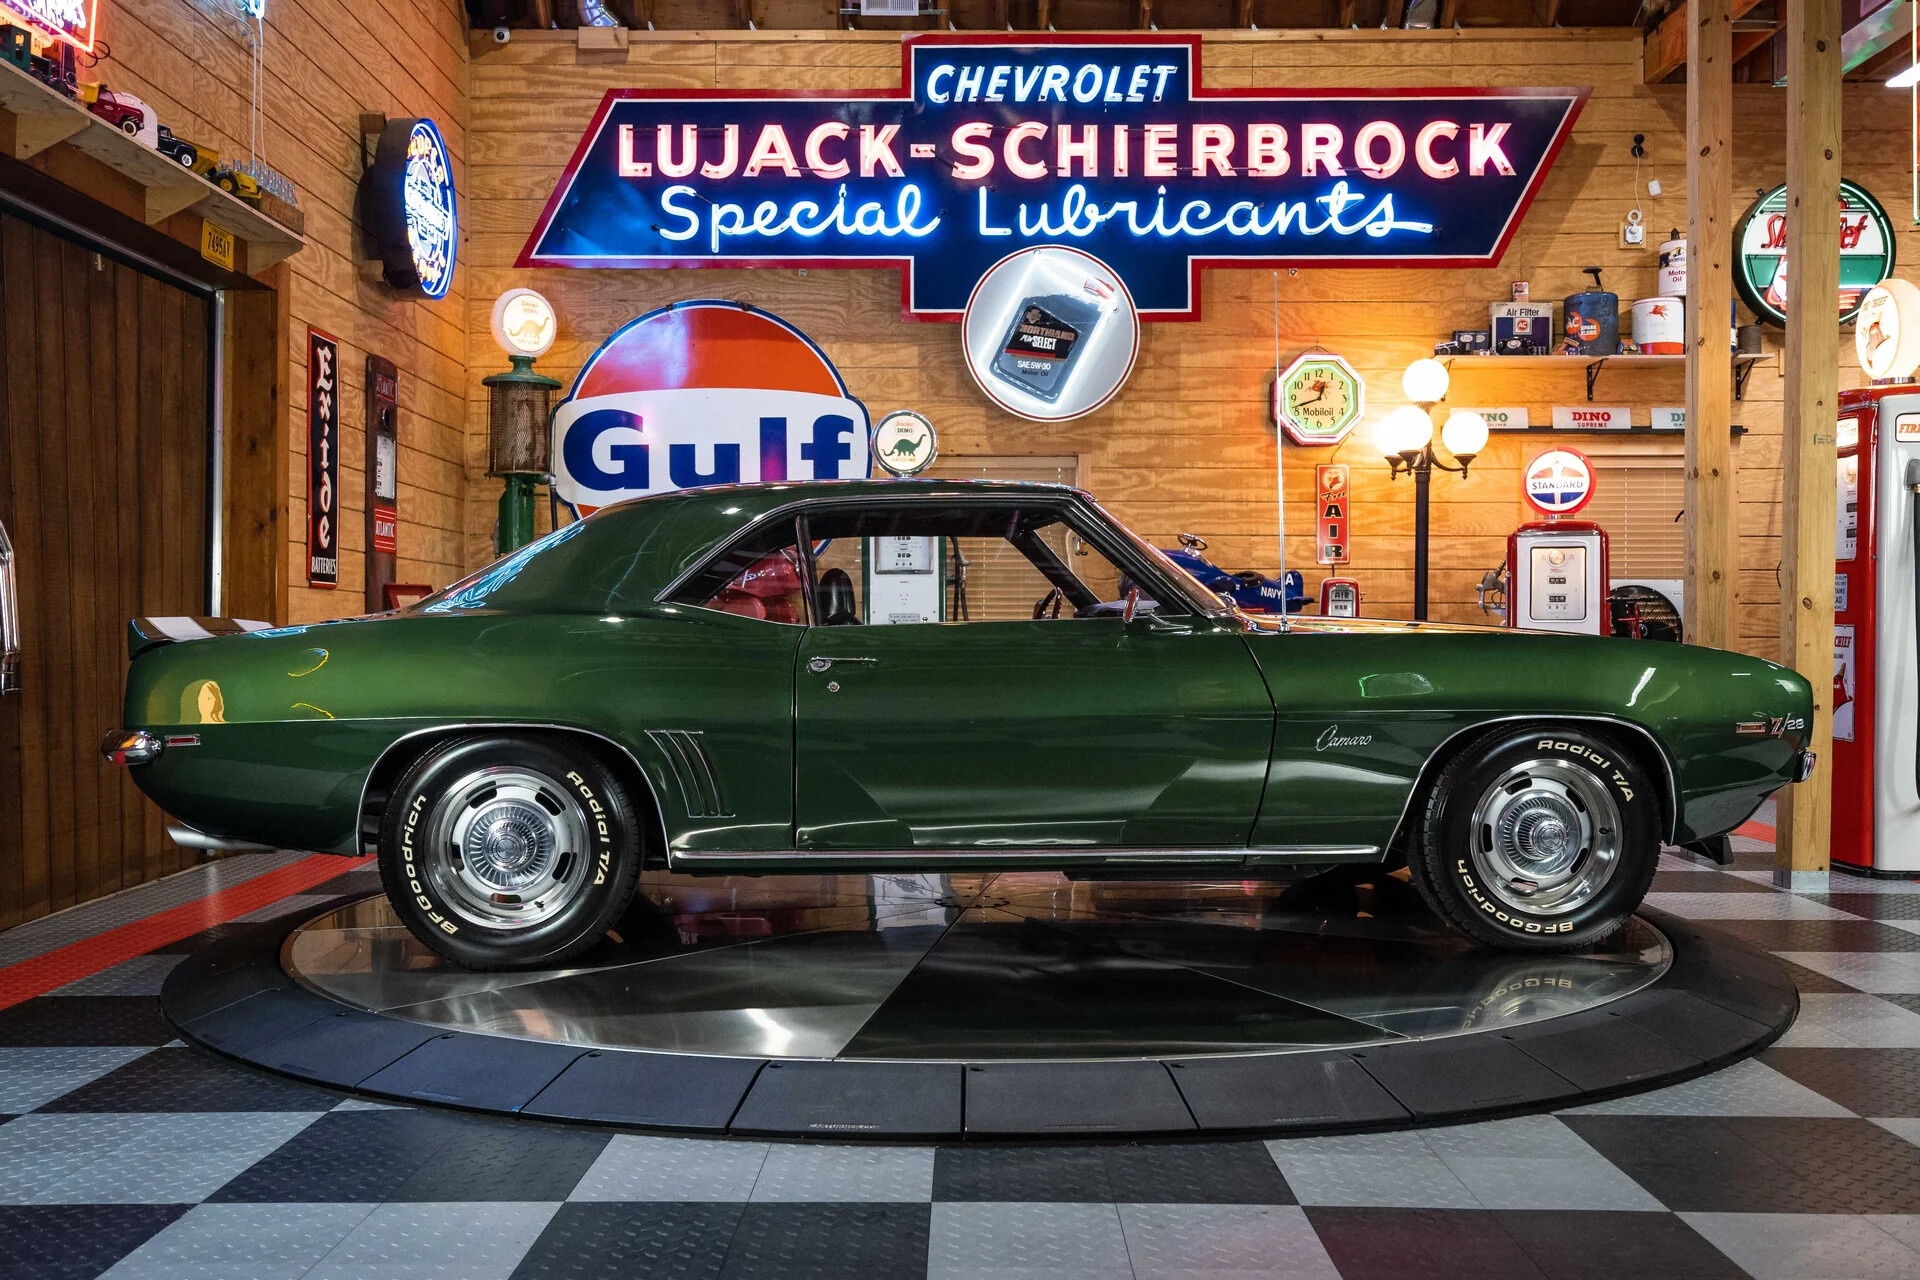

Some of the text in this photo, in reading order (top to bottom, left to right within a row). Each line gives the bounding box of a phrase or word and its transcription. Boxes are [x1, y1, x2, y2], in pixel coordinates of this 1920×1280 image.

[927, 64, 1177, 103] CHEVROLET
[658, 181, 1433, 253] Special Lubricants
[1506, 308, 1541, 317] Air Filter
[1017, 360, 1052, 371] SAE 5W-30
[1303, 372, 1310, 381] 11
[1315, 368, 1324, 378] 12
[1330, 372, 1334, 381] 1
[1294, 380, 1304, 390] 10
[1338, 380, 1344, 390] 2
[1290, 394, 1297, 402] 9
[1302, 407, 1334, 417] Mobiloil
[1338, 407, 1344, 416] 4
[1571, 411, 1612, 422] DINO
[1303, 417, 1309, 426] 7
[1316, 420, 1323, 429] 6
[1330, 416, 1336, 426] 5
[562, 408, 855, 491] Gulf
[1531, 480, 1584, 490] STANDARD
[1320, 491, 1346, 502] Free
[374, 520, 396, 539] ATLANTIC
[1323, 503, 1344, 559] AIR
[311, 555, 337, 576] BATTERIES
[1285, 573, 1295, 586] A
[1260, 586, 1282, 600] NAVY
[1334, 591, 1350, 599] AIR
[1770, 712, 1805, 739] Z/28
[1315, 724, 1372, 752] Camaro
[1537, 739, 1635, 802] Radial T/A
[565, 771, 611, 885] Radial T/A
[401, 794, 460, 936] BFGoodrich
[1457, 859, 1575, 934] BFGoodrich
